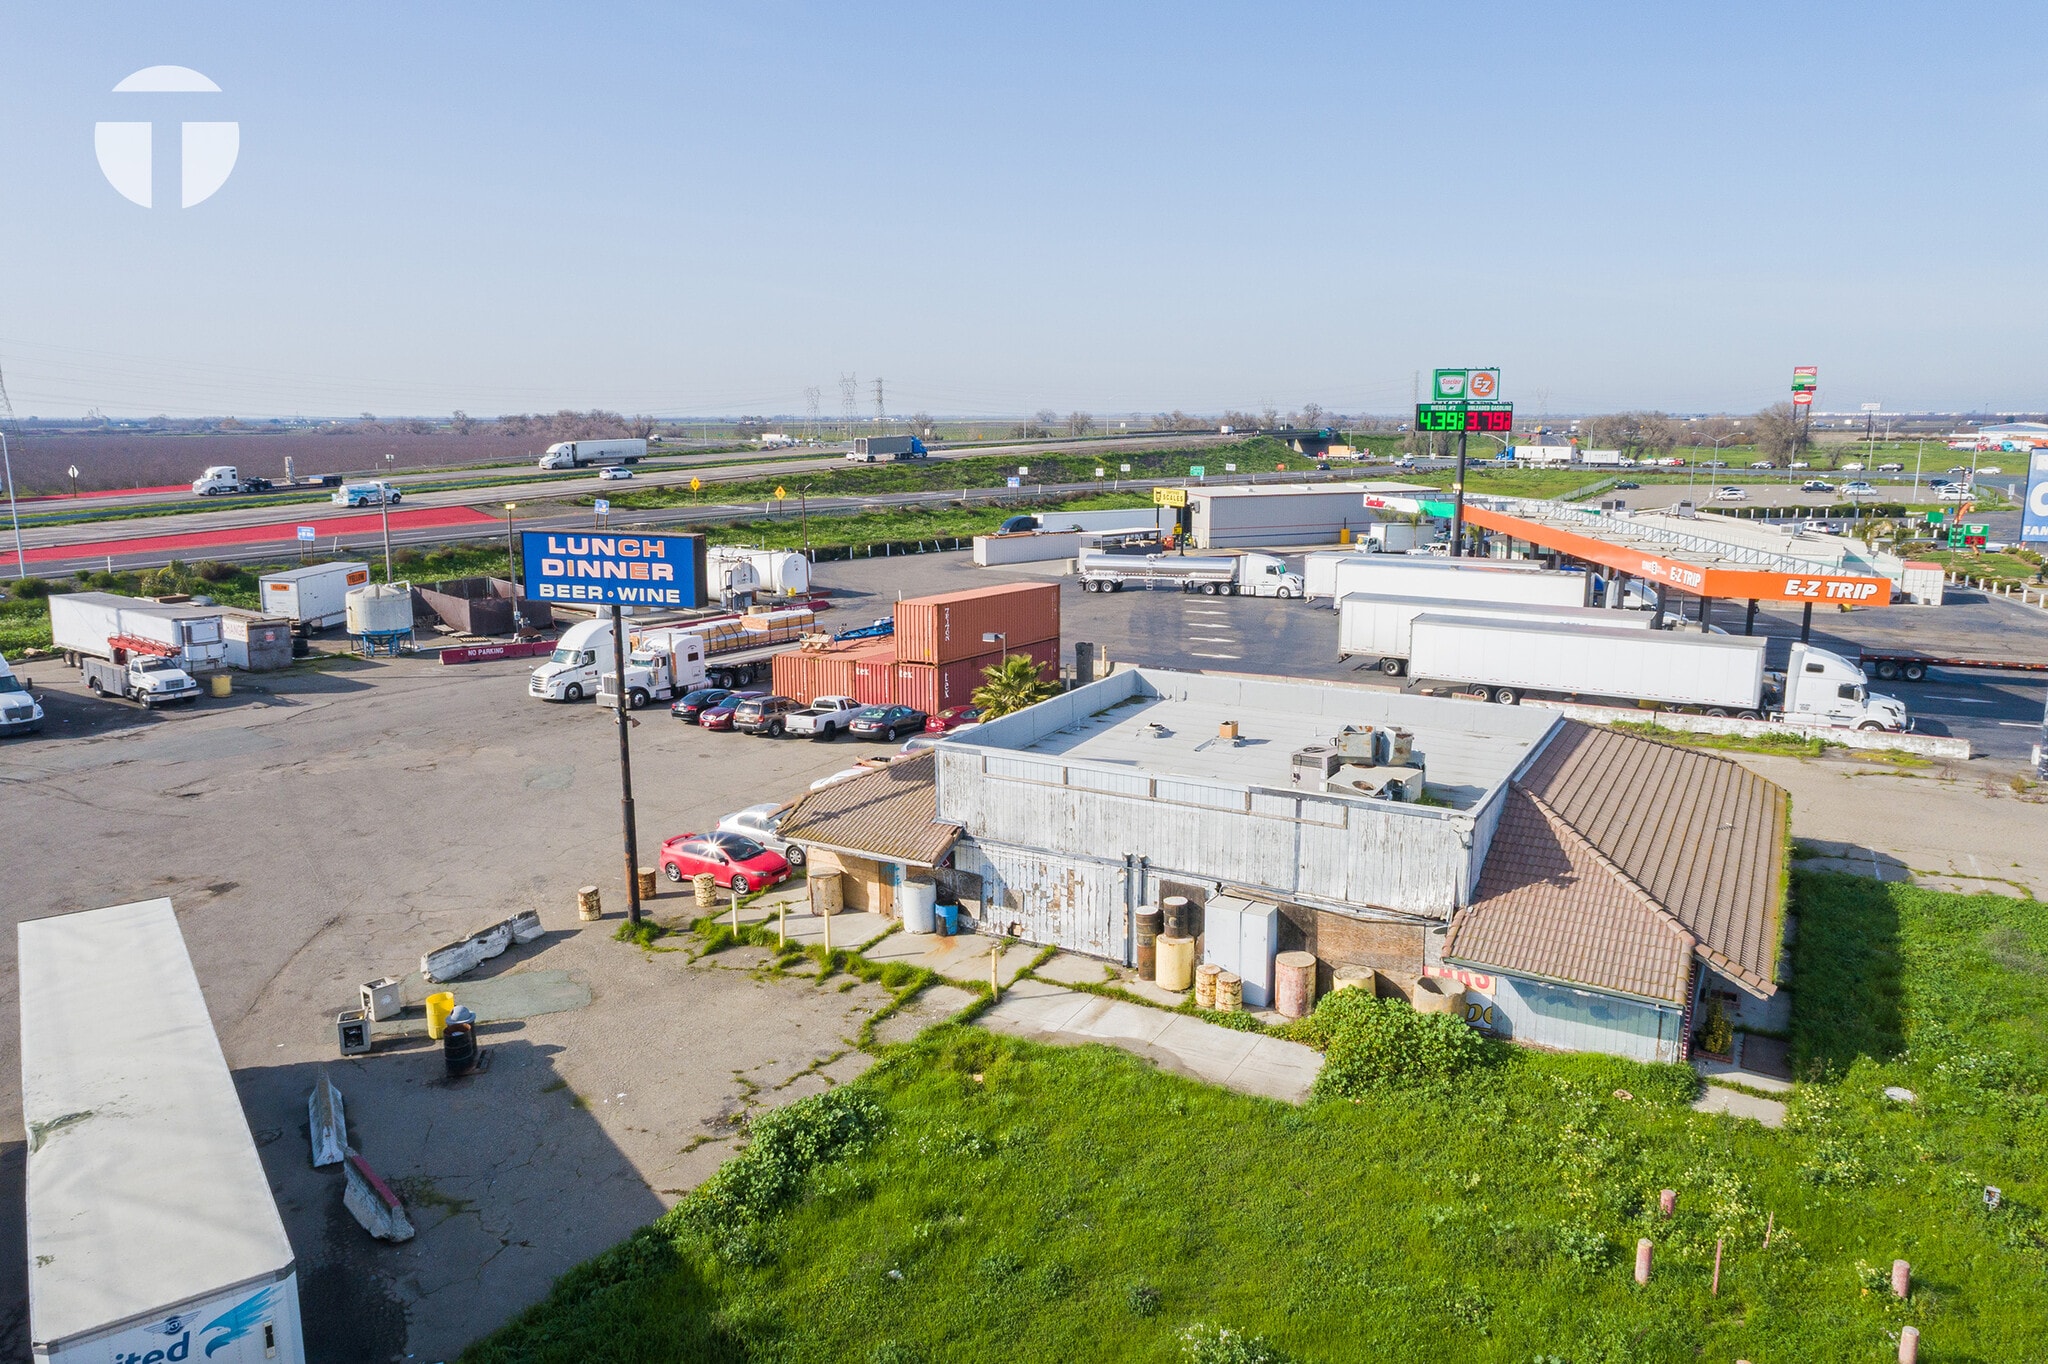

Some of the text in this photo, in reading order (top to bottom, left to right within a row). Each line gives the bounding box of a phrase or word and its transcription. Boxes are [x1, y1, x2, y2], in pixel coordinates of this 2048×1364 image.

[548, 536, 665, 558] LUNCH
[541, 558, 674, 581] DINNER
[1683, 569, 1702, 588] TRIP
[539, 583, 681, 604] BEER WINE
[1784, 579, 1879, 600] E-Z TRIP
[478, 647, 504, 656] PARKING
